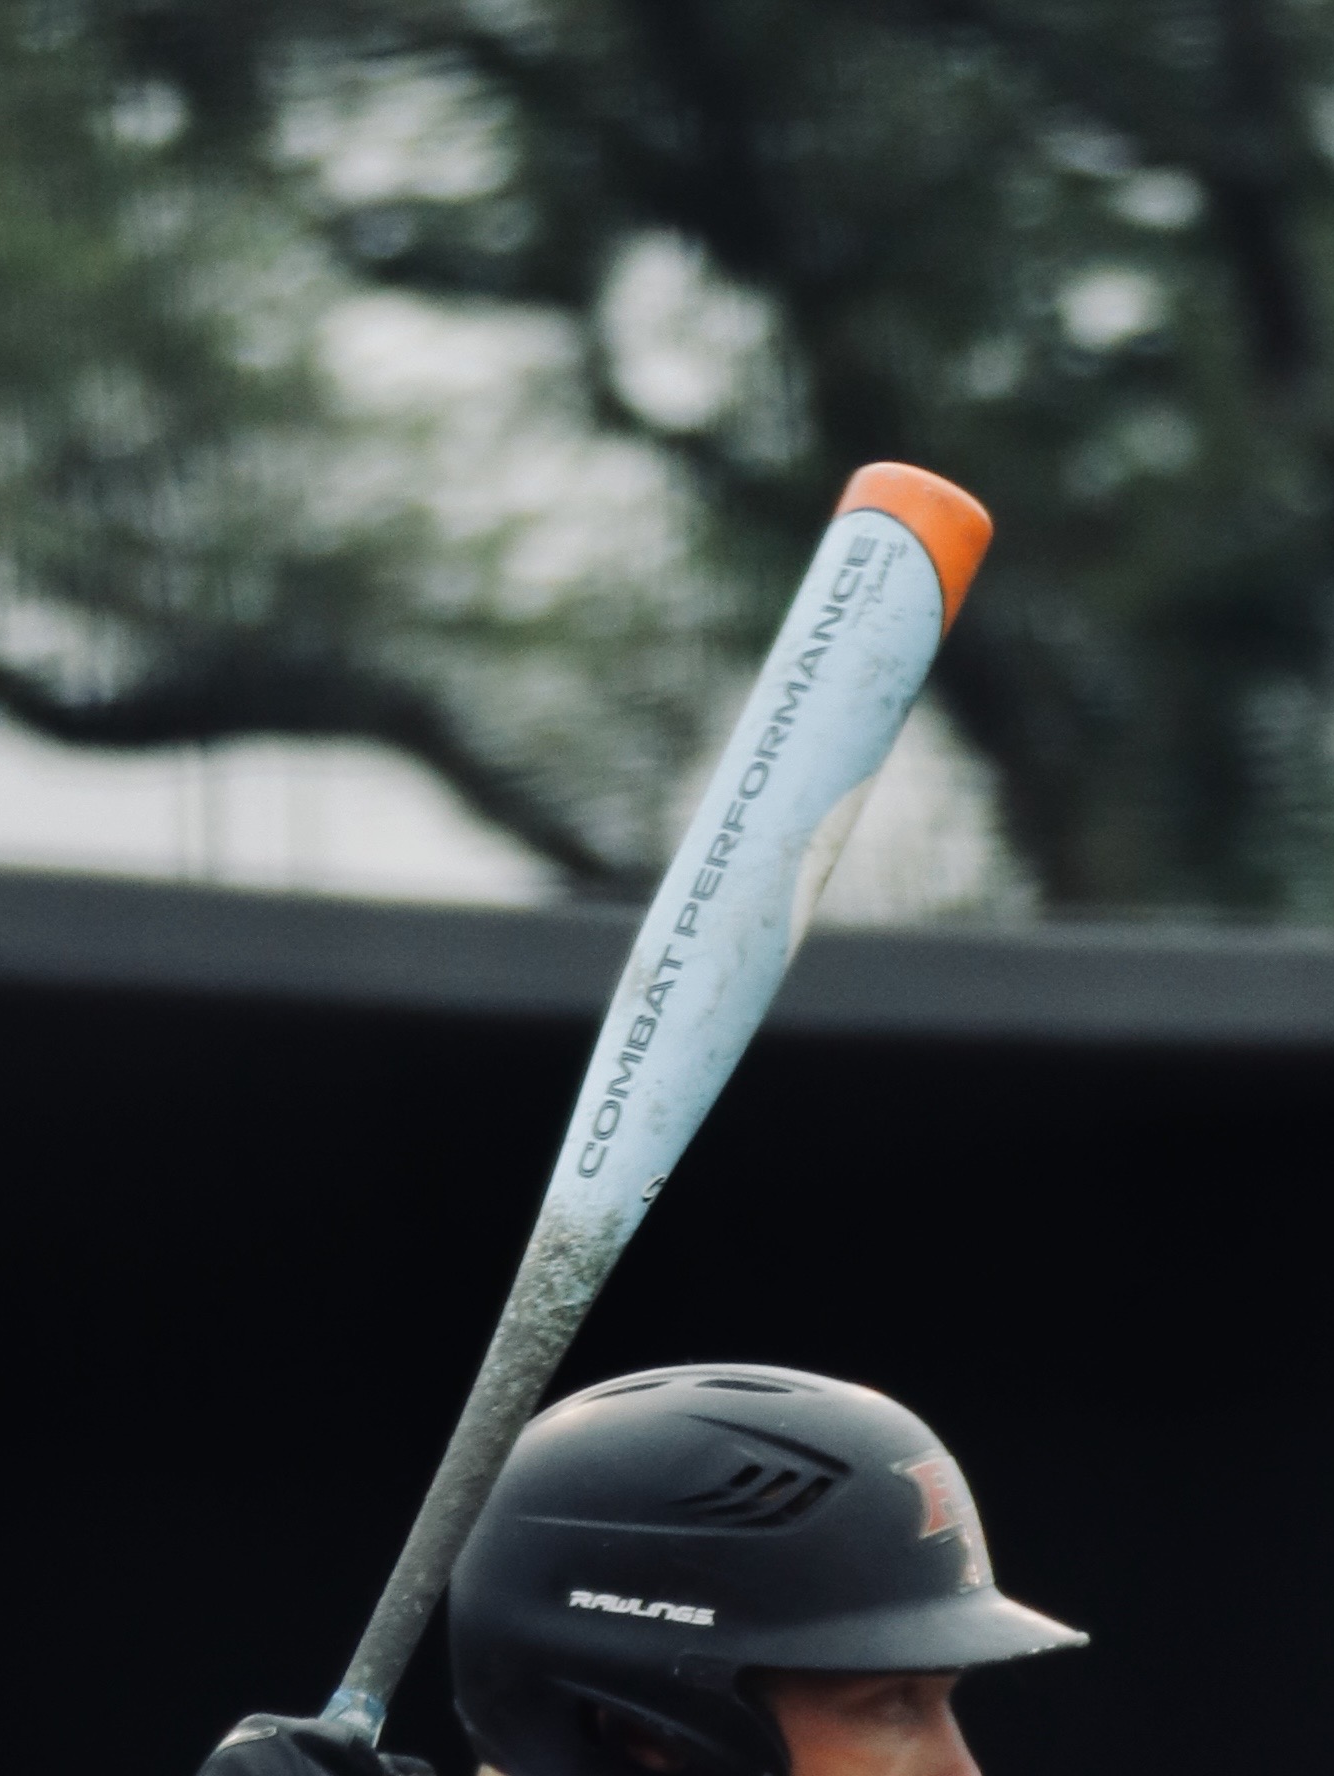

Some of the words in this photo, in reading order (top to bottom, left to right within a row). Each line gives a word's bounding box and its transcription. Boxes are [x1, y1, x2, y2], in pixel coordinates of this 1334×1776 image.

[577, 943, 684, 1179] COMBAT
[673, 534, 880, 938] PERFORMANCE
[568, 1589, 716, 1627] RAWLINGS
